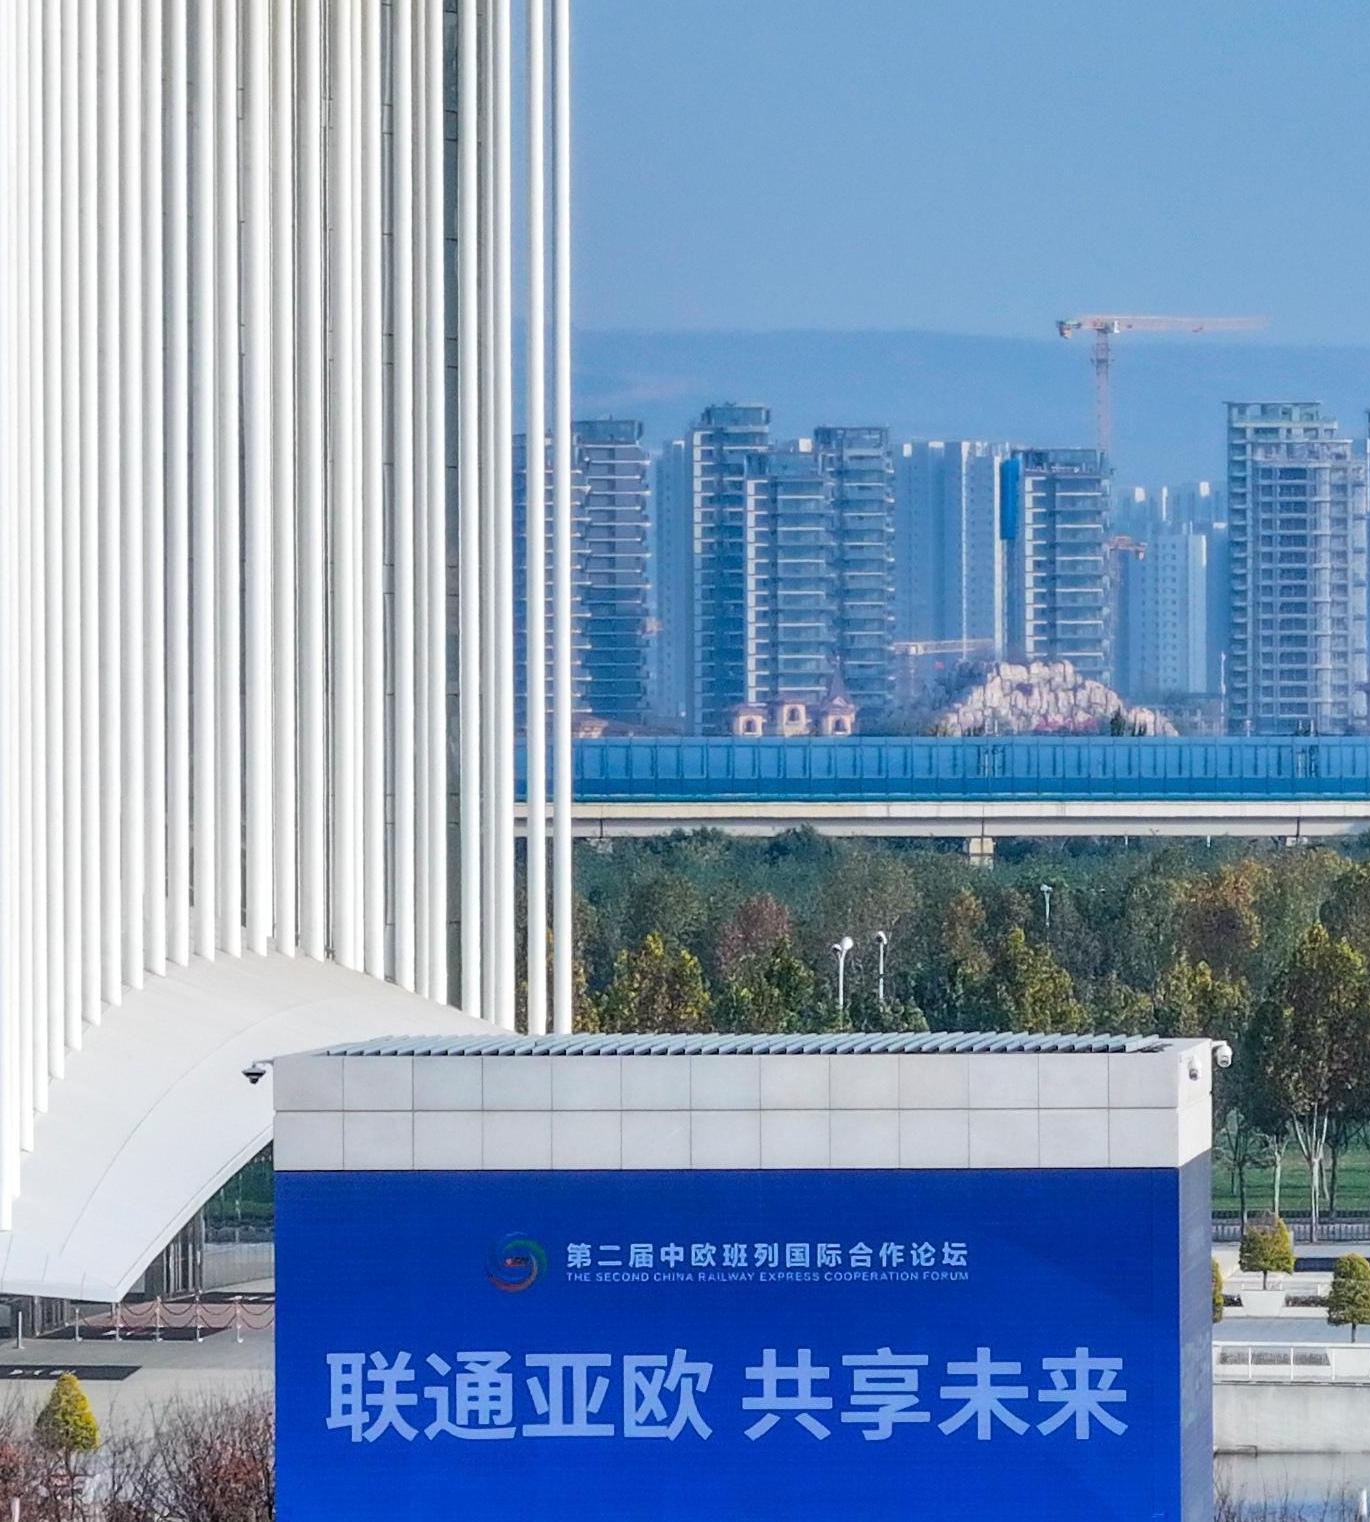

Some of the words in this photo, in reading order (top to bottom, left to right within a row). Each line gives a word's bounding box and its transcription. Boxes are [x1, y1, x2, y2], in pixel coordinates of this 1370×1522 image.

[566, 1241, 968, 1269] 第二届中欧班列国际合作论坛
[567, 1272, 591, 1282] THE
[596, 1272, 650, 1282] SECOND
[653, 1272, 694, 1282] CHINA
[698, 1272, 754, 1282] RAILWAY
[759, 1271, 820, 1282] EXPRESS
[824, 1271, 919, 1282] COOPERATION
[923, 1271, 969, 1281] FORUM
[326, 1348, 713, 1442] 联通亚欧
[742, 1347, 1128, 1440] 共享未来
